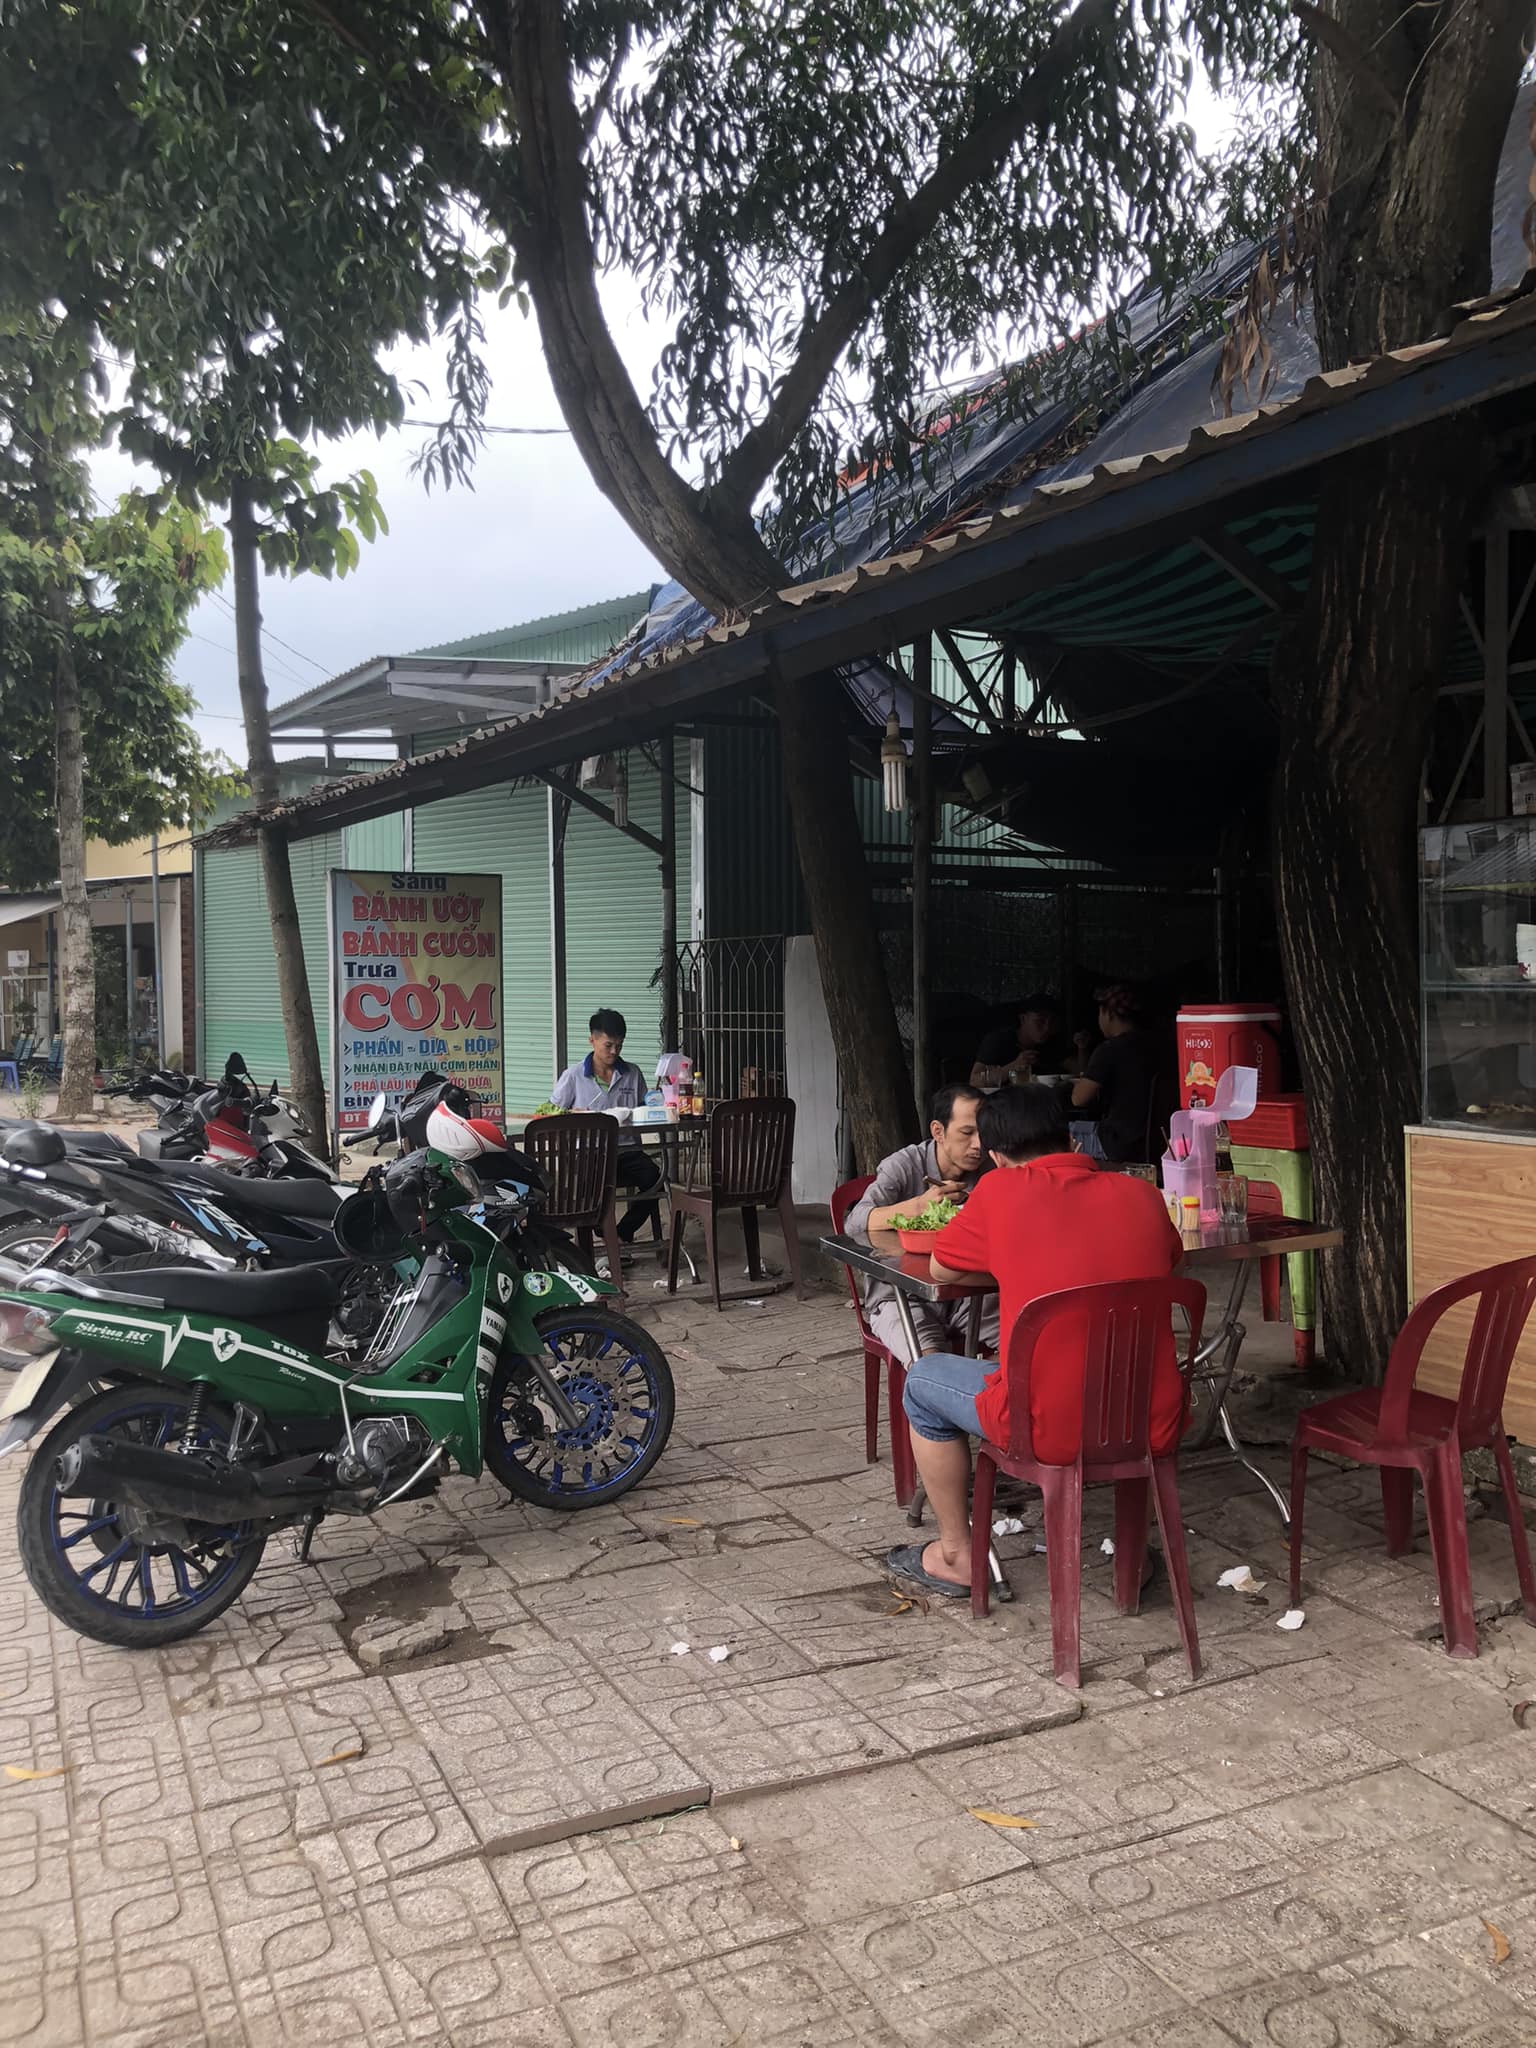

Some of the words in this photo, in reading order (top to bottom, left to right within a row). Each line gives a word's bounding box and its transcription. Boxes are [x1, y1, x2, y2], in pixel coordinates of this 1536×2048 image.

[352, 891, 428, 921] BÁNH
[432, 892, 485, 922] ƯỚT
[342, 926, 417, 956] BÁNH
[422, 924, 496, 957] CUỐN
[344, 961, 398, 978] Trưa
[343, 975, 497, 1031] CƠM
[464, 1036, 499, 1056] HỘP
[76, 1321, 124, 1337] Sirius
[125, 1330, 153, 1342] RC
